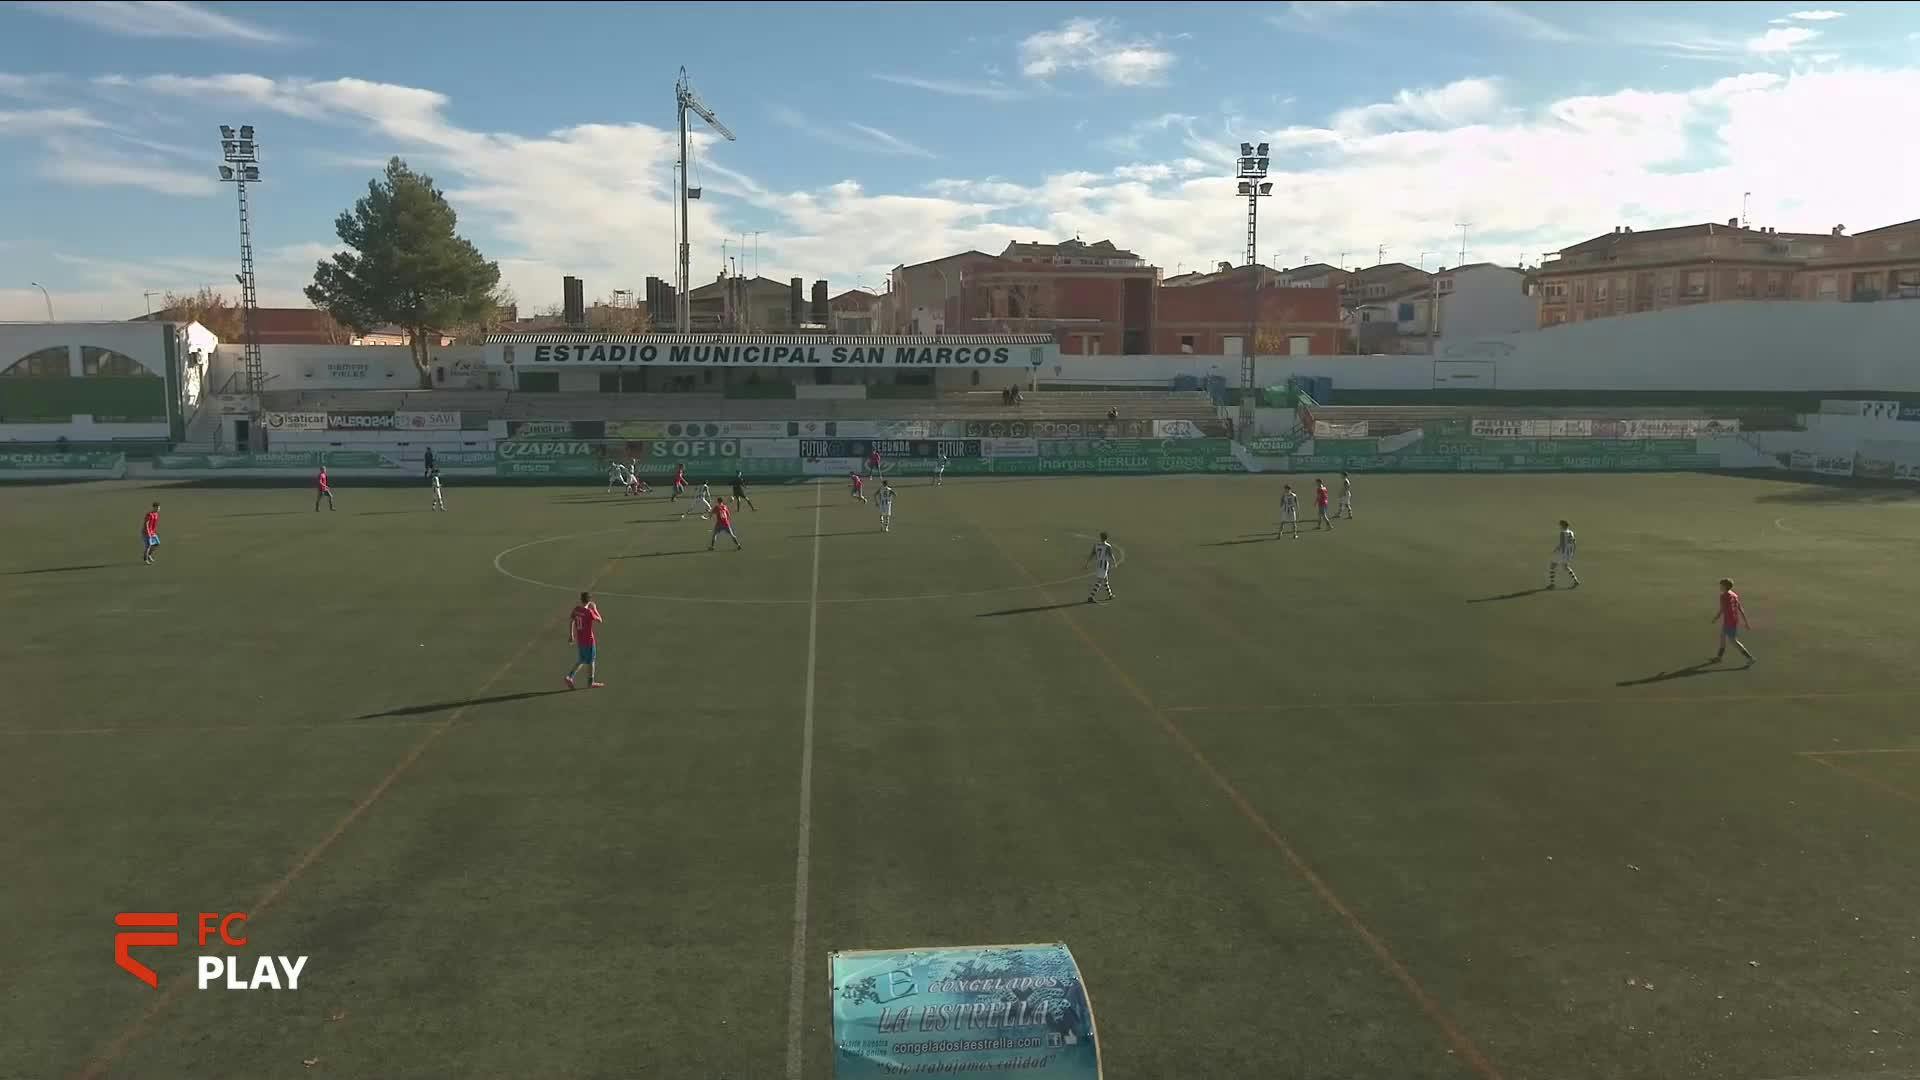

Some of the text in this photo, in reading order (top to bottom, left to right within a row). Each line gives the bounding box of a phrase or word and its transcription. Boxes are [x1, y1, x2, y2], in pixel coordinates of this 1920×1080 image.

[535, 345, 1009, 364] ESTADIO MUNICIPAL SAN MARCOS
[516, 442, 591, 456] ZAPATA
[653, 441, 737, 457] SOFIO
[926, 976, 1058, 993] CONGELADOS
[878, 1000, 1050, 1034] LA ESTRELLA
[893, 1037, 1041, 1055] congeladoslaestrella.com
[915, 1058, 993, 1077] trabajamos
